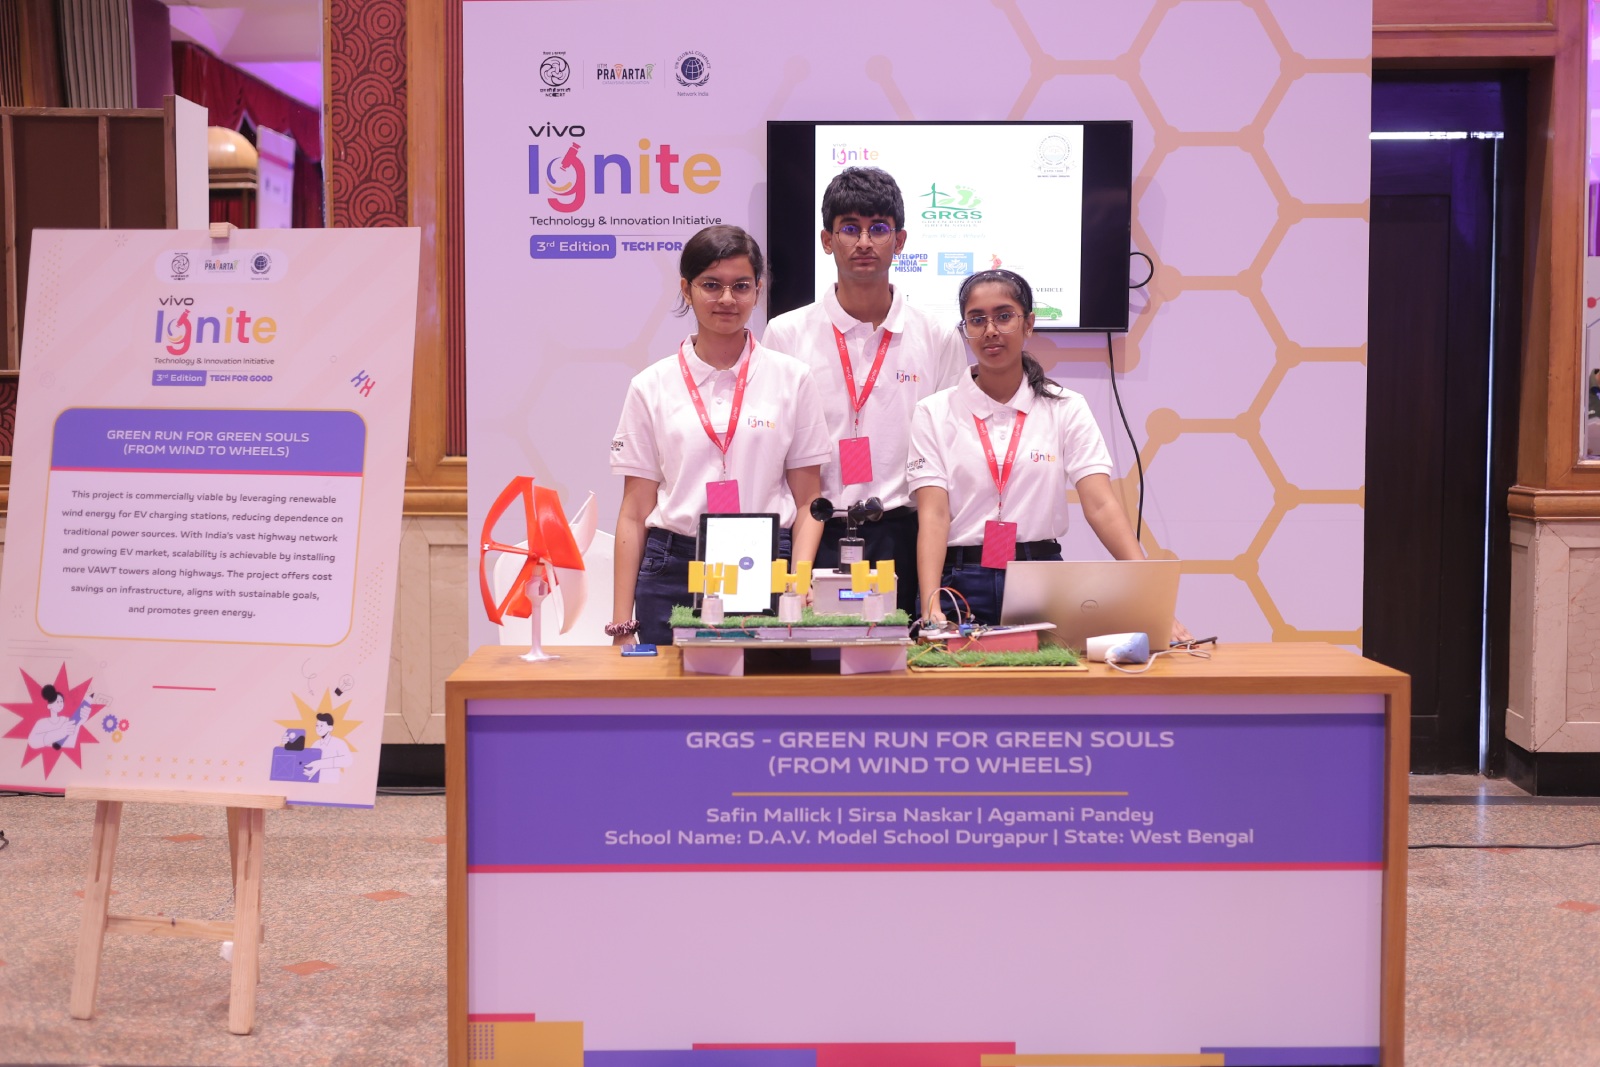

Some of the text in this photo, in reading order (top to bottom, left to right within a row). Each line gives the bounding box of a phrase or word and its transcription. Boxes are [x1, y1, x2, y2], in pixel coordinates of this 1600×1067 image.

[597, 64, 654, 80] PRAVARTAK
[528, 122, 585, 137] vivo
[832, 148, 879, 165] Ignite
[528, 138, 721, 212] Ignite
[530, 215, 721, 228] Technology & Innovation Initiative
[921, 210, 982, 219] GRGS
[536, 240, 682, 252] 3rd Edition TECH FOR
[159, 295, 194, 306] vivo
[154, 306, 277, 355] Ignite
[154, 357, 195, 366] Technology
[156, 374, 169, 382] 3rd
[170, 374, 203, 382] Edition
[107, 430, 310, 442] GREEN RUN FOR GREEN SOULS
[123, 443, 290, 458] (FROM WIND TO WHEELS)
[1030, 451, 1056, 462] Ignite
[71, 490, 337, 505] This project is commercially viable by leveraging renewable
[61, 508, 84, 517] wind
[84, 511, 116, 520] energy
[118, 509, 132, 518] for
[133, 510, 148, 519] EV
[148, 510, 188, 522] charging
[190, 512, 230, 522] stations,
[231, 513, 272, 524] reducing
[273, 513, 329, 523] dependence
[63, 527, 110, 537] traditional
[111, 530, 140, 538] power
[180, 530, 203, 539] With
[257, 532, 297, 543] highway
[299, 534, 338, 542] network
[62, 546, 336, 564] and growing EV market, scalability is achievable by installing
[62, 565, 333, 581] more VAWT towers along highways. The project offers cost
[70, 584, 104, 595] savings
[186, 587, 213, 598] aligns
[215, 588, 236, 597] with
[238, 589, 290, 599] sustainable
[128, 605, 256, 619] and promotes green energy.
[686, 732, 755, 748] GRGS
[779, 731, 865, 748] GREEN
[874, 731, 928, 748] RUN
[937, 731, 988, 748] FOR
[996, 731, 1082, 748] GREEN
[1090, 731, 1174, 748] SOULS
[769, 755, 1092, 777] (FROM WIND TO WHEELS)
[706, 807, 757, 822] Safin
[764, 807, 831, 822] Mallick
[848, 807, 896, 822] Sirsa
[904, 807, 972, 822] Naskar
[988, 807, 1074, 826] Agamani
[1081, 807, 1153, 826] Pandey
[605, 829, 671, 845] School
[678, 830, 741, 844] Name:
[749, 830, 810, 844] D.A.V.
[818, 829, 877, 844] Model
[883, 829, 949, 844] School
[956, 830, 1048, 848] Durgapur
[1064, 829, 1124, 844] State:
[1130, 829, 1181, 844] West
[1188, 829, 1253, 848] Bengal
